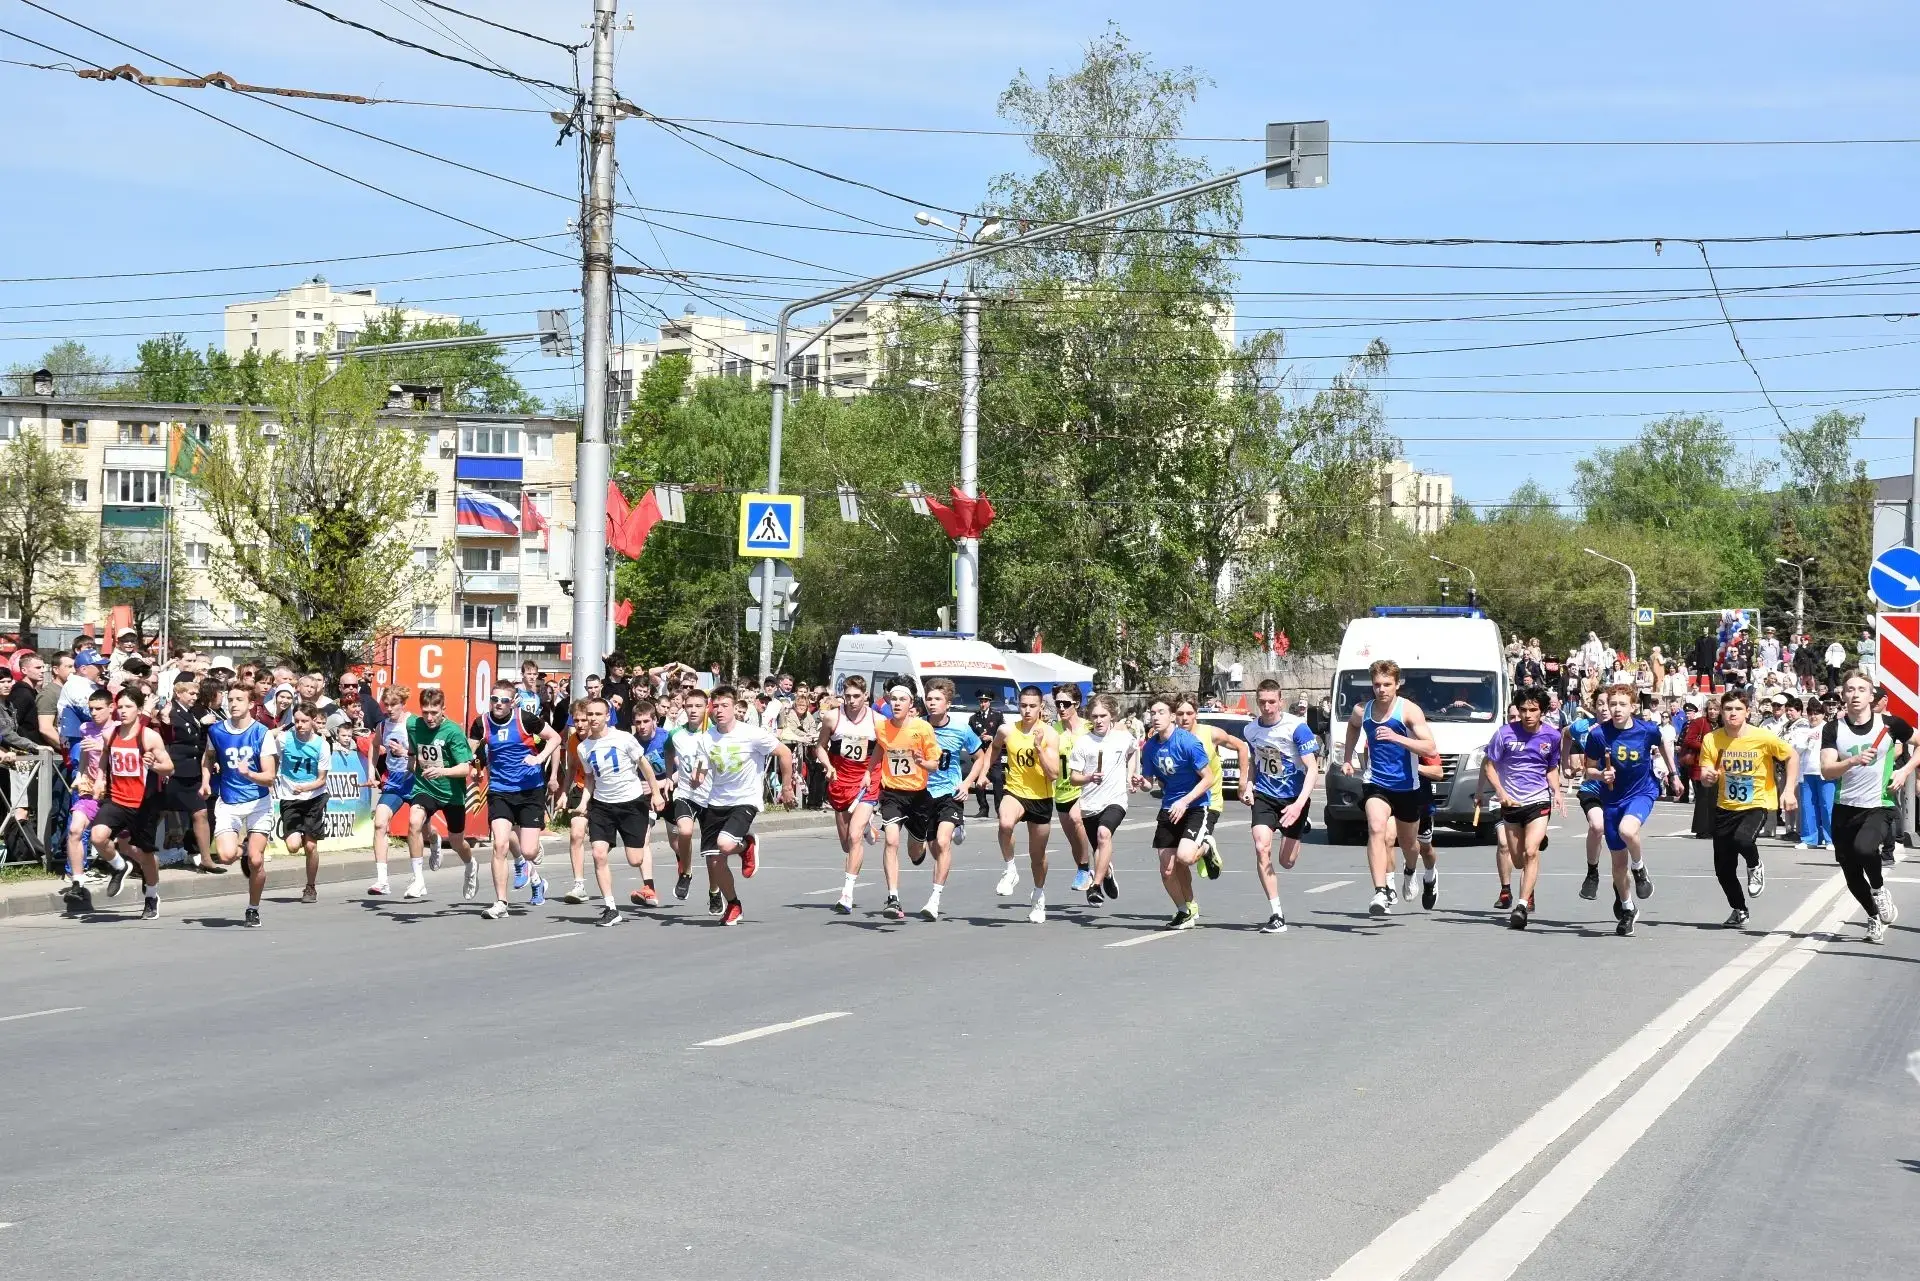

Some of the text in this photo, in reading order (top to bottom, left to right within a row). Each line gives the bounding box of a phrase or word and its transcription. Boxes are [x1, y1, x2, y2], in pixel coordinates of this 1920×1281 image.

[934, 660, 993, 669] РЕАНИМАЦИЯ
[421, 745, 439, 761] 69
[844, 744, 863, 760] 29
[1508, 741, 1526, 752] 77
[113, 751, 138, 772] 30
[225, 745, 254, 769] 32
[291, 755, 312, 774] 71
[587, 746, 620, 773] 11
[1016, 748, 1035, 767] 68
[1158, 756, 1176, 775] 58
[1262, 757, 1278, 775] 76
[1723, 759, 1753, 772] САН
[891, 759, 911, 775] 73
[327, 774, 360, 800] ЦИЯ
[1728, 782, 1748, 802] 93
[323, 813, 355, 838] ЕНЗЫ
